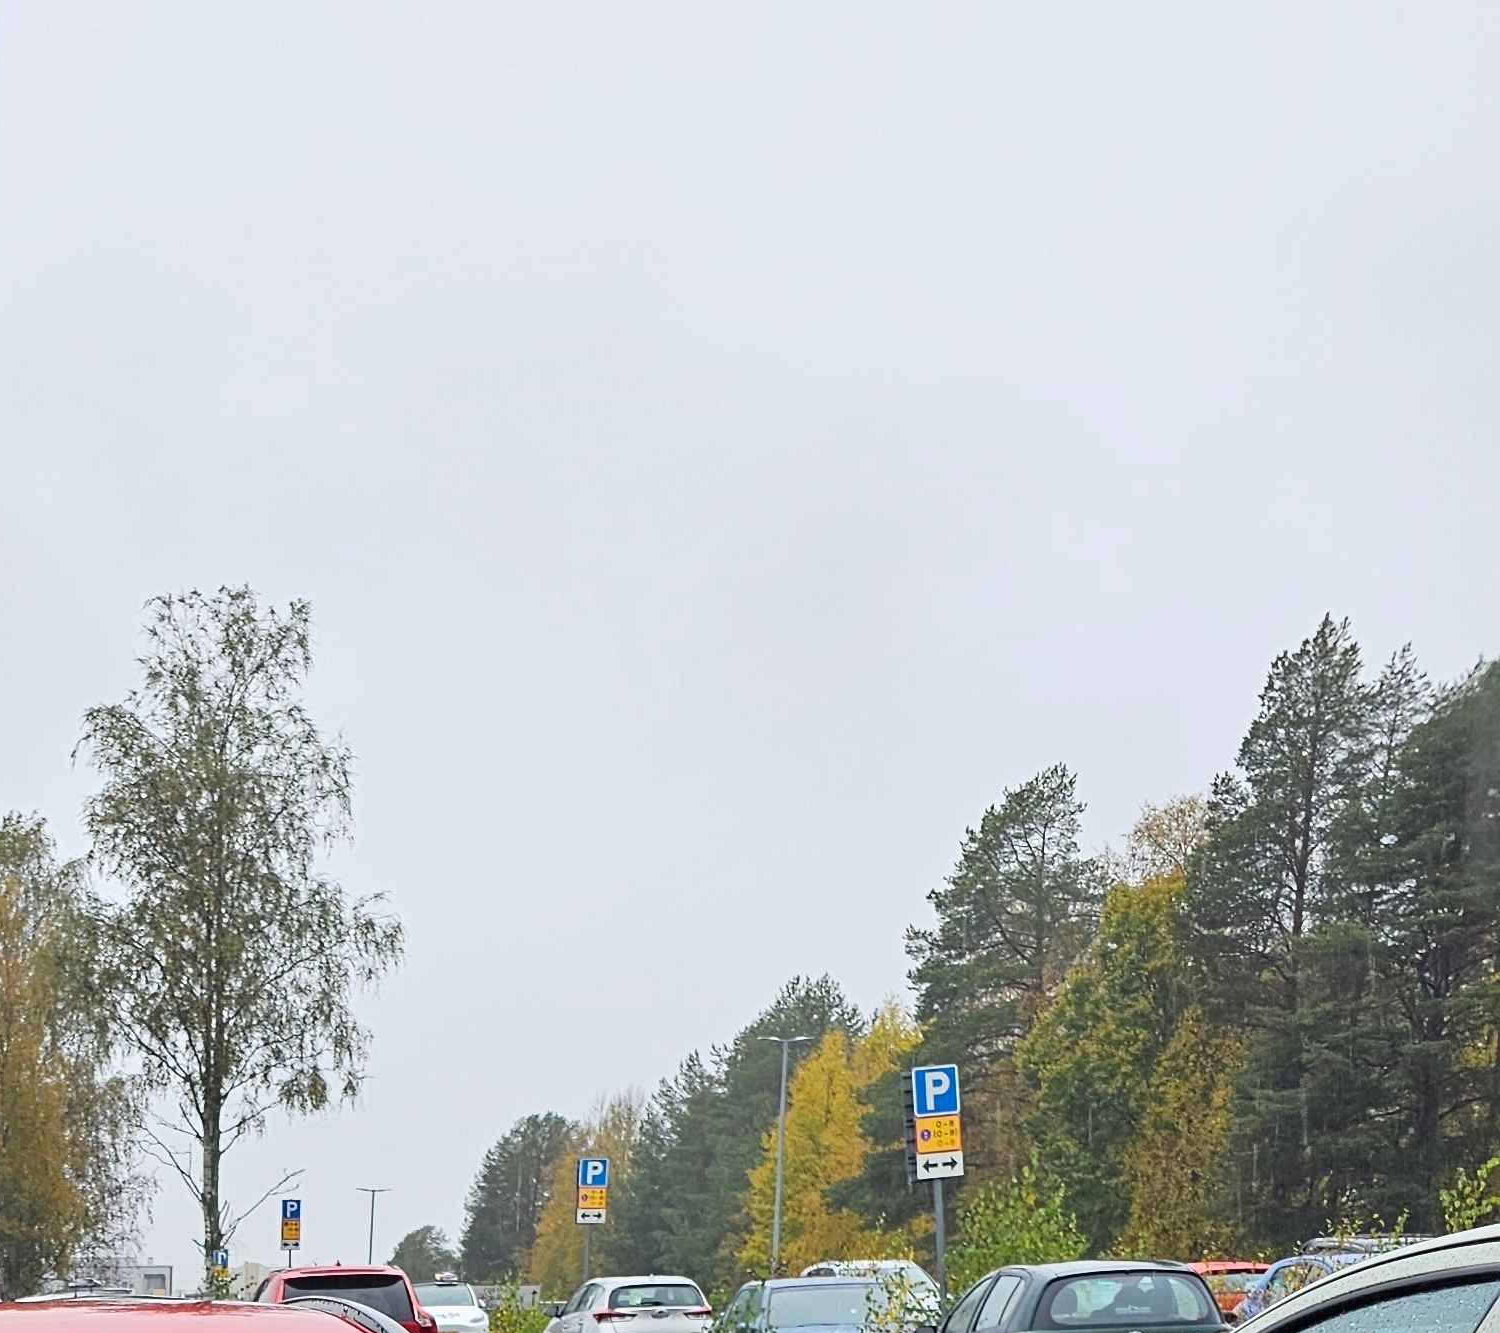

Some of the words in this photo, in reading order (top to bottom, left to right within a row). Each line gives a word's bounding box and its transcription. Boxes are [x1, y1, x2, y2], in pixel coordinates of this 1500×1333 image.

[925, 1071, 950, 1111] P
[587, 1161, 604, 1185] P
[287, 1202, 298, 1218] P
